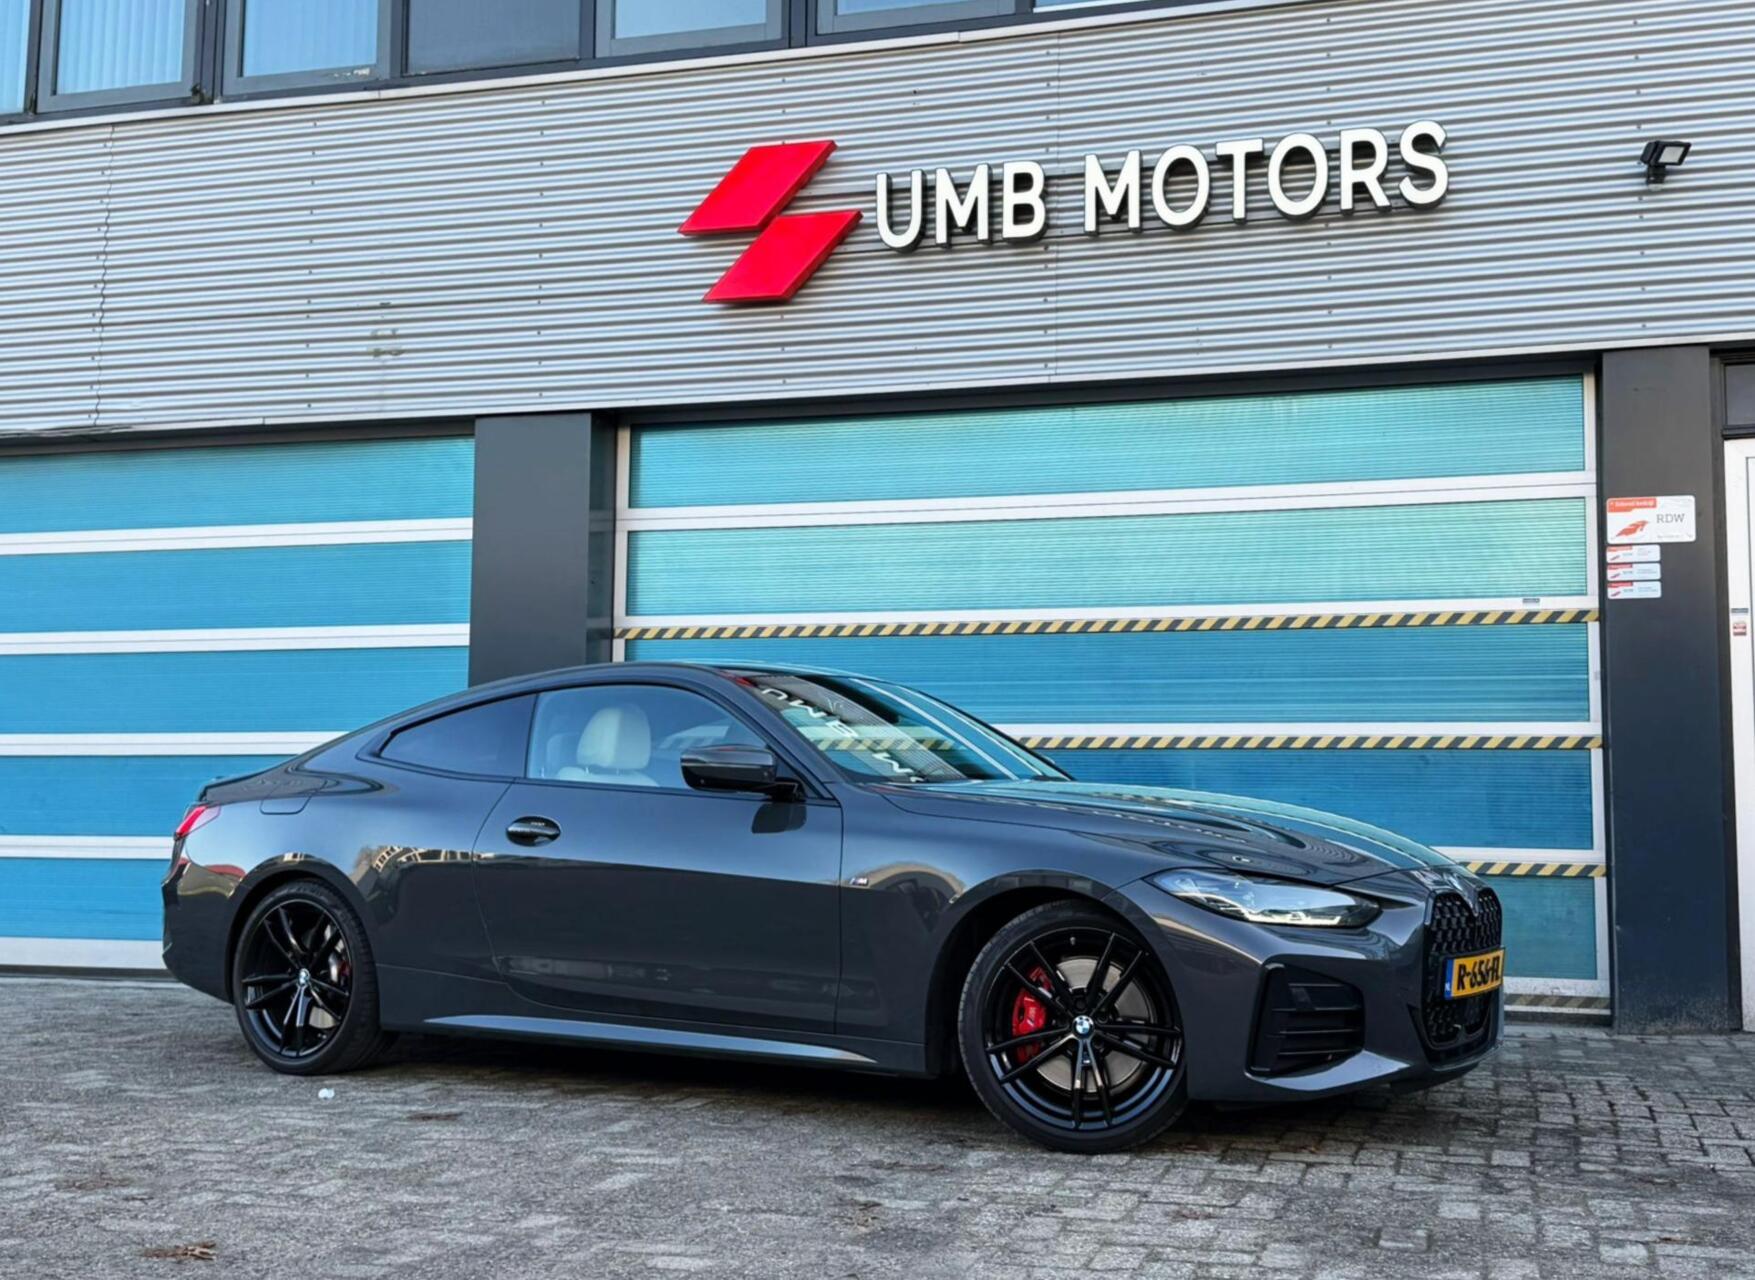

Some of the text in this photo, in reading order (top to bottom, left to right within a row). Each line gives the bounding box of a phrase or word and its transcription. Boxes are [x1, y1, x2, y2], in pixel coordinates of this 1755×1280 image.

[876, 119, 1449, 249] UMB MOTORS
[1656, 514, 1685, 524] RDW
